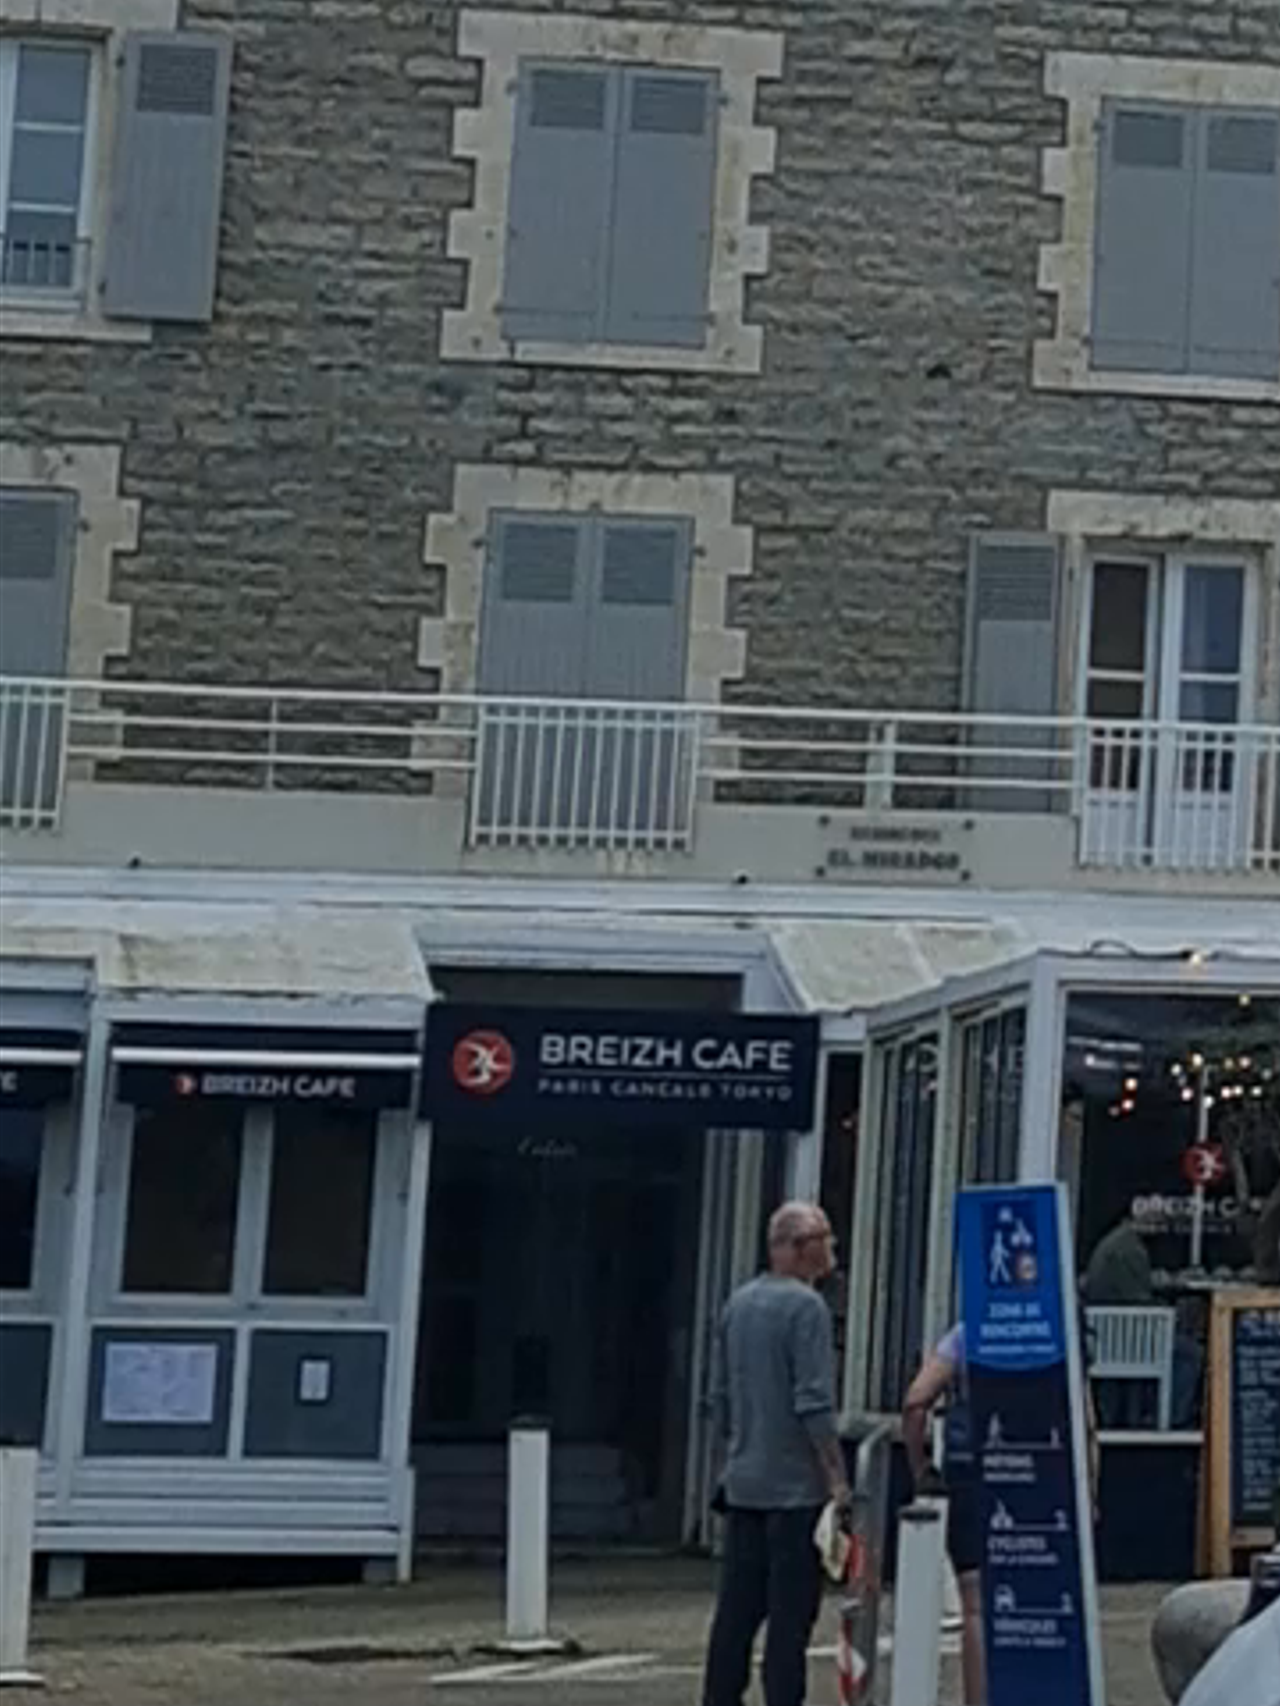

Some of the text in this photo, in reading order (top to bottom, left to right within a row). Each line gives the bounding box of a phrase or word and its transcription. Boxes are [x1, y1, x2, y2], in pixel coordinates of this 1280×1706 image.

[539, 1034, 794, 1071] BREIZH CAFE
[201, 1074, 356, 1098] BREIZH CAFE
[537, 1078, 792, 1102] PARIS CANCALE TOKYO
